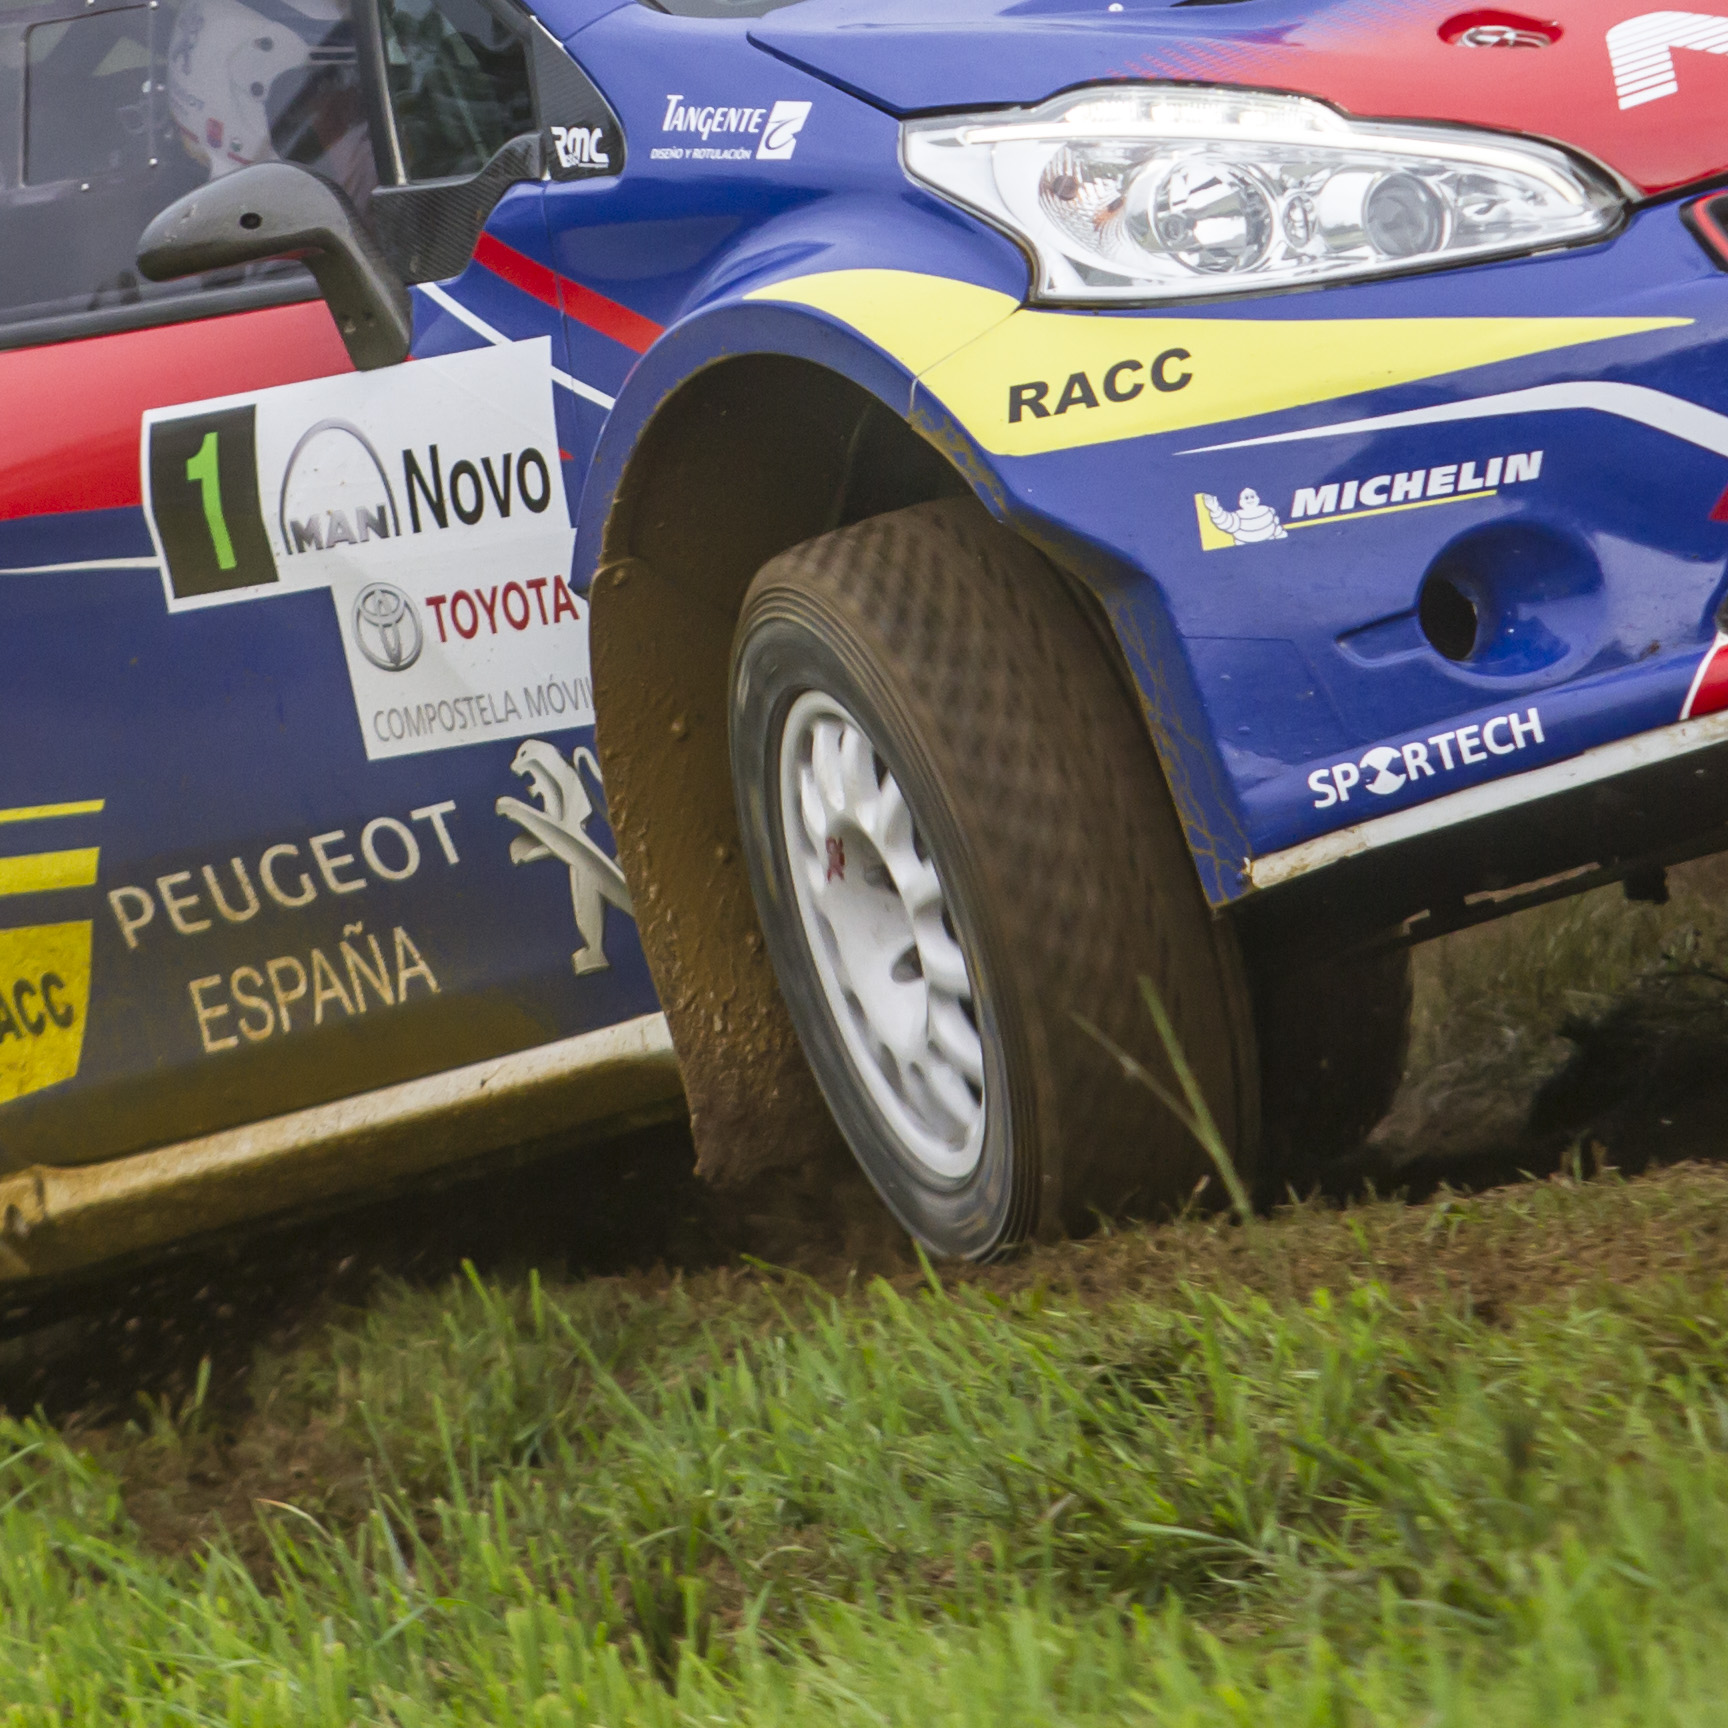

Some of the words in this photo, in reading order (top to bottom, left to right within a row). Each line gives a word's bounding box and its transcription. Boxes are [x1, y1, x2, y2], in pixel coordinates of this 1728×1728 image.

[1008, 347, 1194, 423] RACC
[187, 432, 237, 571] 1
[1290, 450, 1544, 519] MICHELIN
[290, 503, 391, 554] MAN
[425, 574, 580, 643] TOYOTA
[373, 689, 522, 742] COMPOSTELA
[107, 800, 460, 950] PEUGEOT
[189, 920, 442, 1053] ESPAÑA
